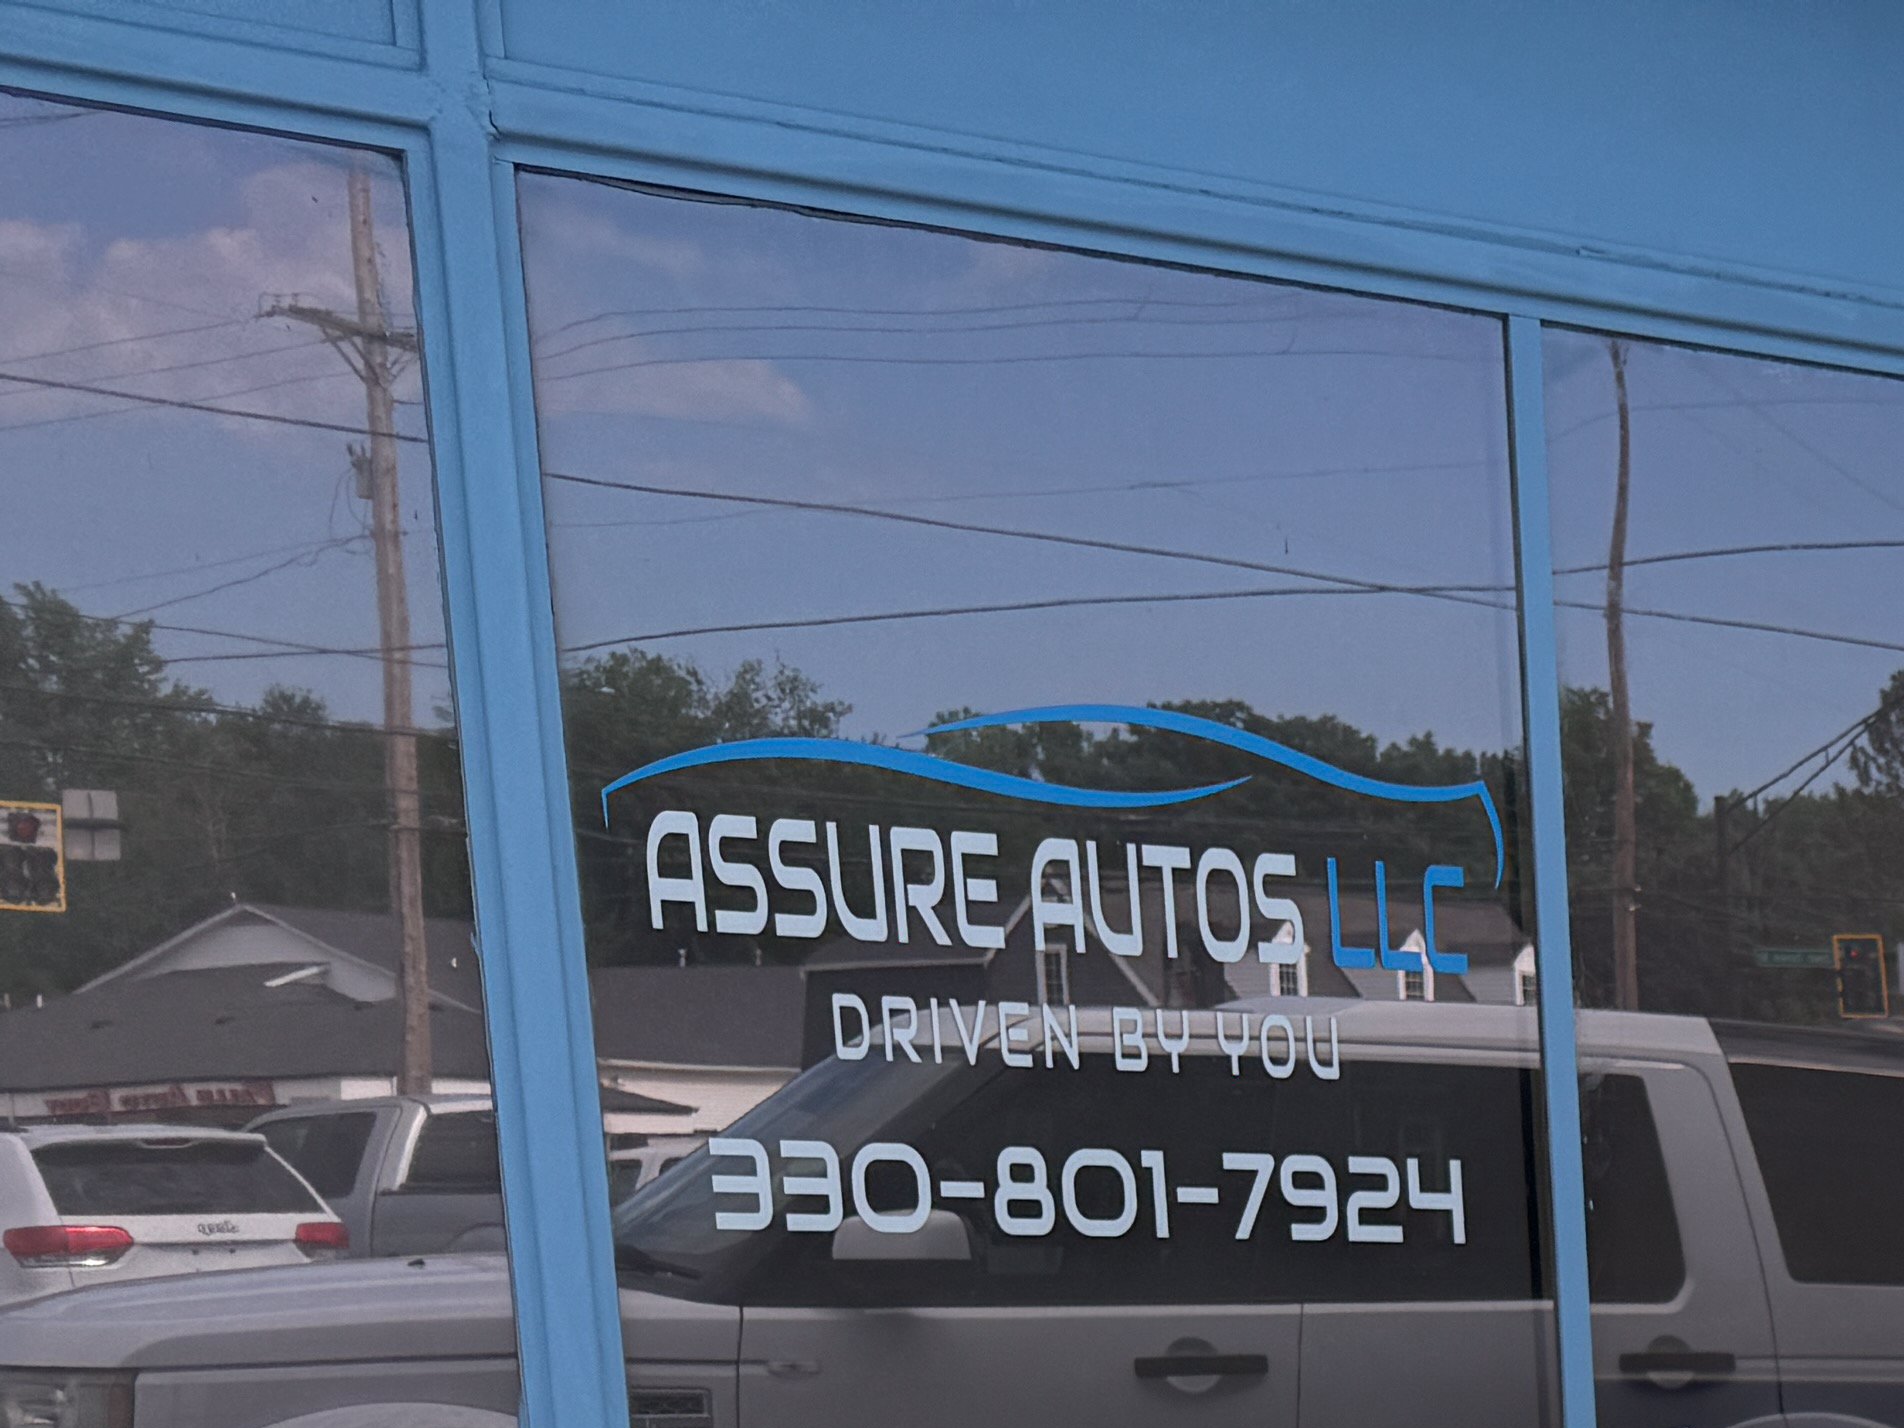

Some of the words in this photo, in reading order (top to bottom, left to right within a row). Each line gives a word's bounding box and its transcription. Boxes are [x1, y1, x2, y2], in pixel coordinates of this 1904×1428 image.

[646, 810, 1006, 950] ASSURE
[1032, 836, 1305, 965] AUTOS
[1325, 856, 1469, 974] LLC
[832, 992, 1083, 1072] DRIVEN
[1112, 1006, 1189, 1075] BY
[1216, 1013, 1341, 1081] YOU
[708, 1137, 1467, 1246] 330-801-7924
